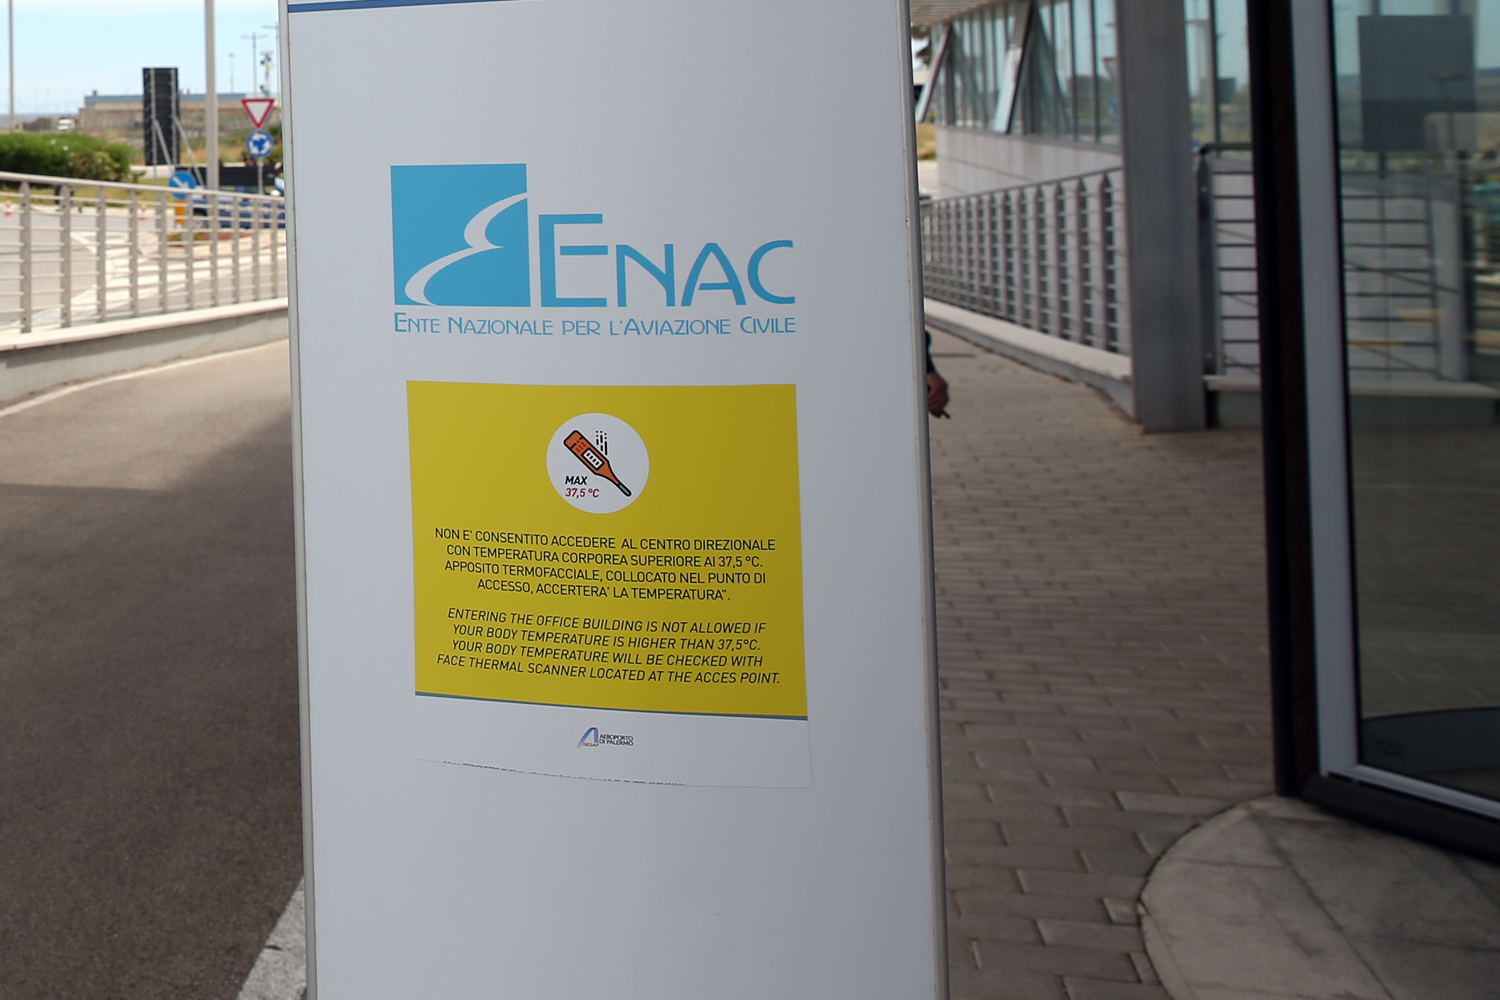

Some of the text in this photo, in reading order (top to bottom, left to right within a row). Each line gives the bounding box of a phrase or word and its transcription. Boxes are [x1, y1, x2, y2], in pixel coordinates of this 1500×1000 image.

[538, 213, 796, 308] ENAC
[562, 319, 600, 336] PER
[565, 476, 588, 485] MAX
[565, 488, 586, 498] 37,5
[435, 528, 460, 540] NON
[475, 531, 548, 546] CONSENTITO
[551, 536, 616, 548] ACCEDERE
[622, 538, 637, 550] AL
[640, 538, 690, 550] CENTRO
[694, 539, 776, 550] DIREZIONALE
[446, 544, 470, 556] CON
[473, 546, 559, 562] TEMPERATURA
[562, 552, 628, 566] CORPOREA
[630, 555, 702, 567] SUPERIORE
[704, 556, 716, 567] AI
[718, 556, 742, 568] 37,5
[445, 560, 766, 584] APPOSITO TERMOFACCIALE, COLLOCATO NEL PUNTO DI
[478, 579, 534, 594] ACCESSO,
[536, 583, 610, 598] ACCERTERA'
[613, 587, 628, 598] LA
[448, 608, 766, 634] ENTERING THE OFFICE BUILDING IS NOT ALLOWED IF
[453, 624, 483, 636] YOUR
[486, 627, 518, 640] BODY
[521, 630, 610, 647] TEMPERATURE
[613, 636, 624, 648] IS
[628, 637, 676, 650] HIGHER
[680, 638, 714, 650] THAN
[452, 640, 763, 666] YOUR BODY TEMPERATURE WILL BE CHECKED WITH
[437, 654, 780, 684] FACE THERMAL SCANNER LOCATED AT THE ACCES POINT.
